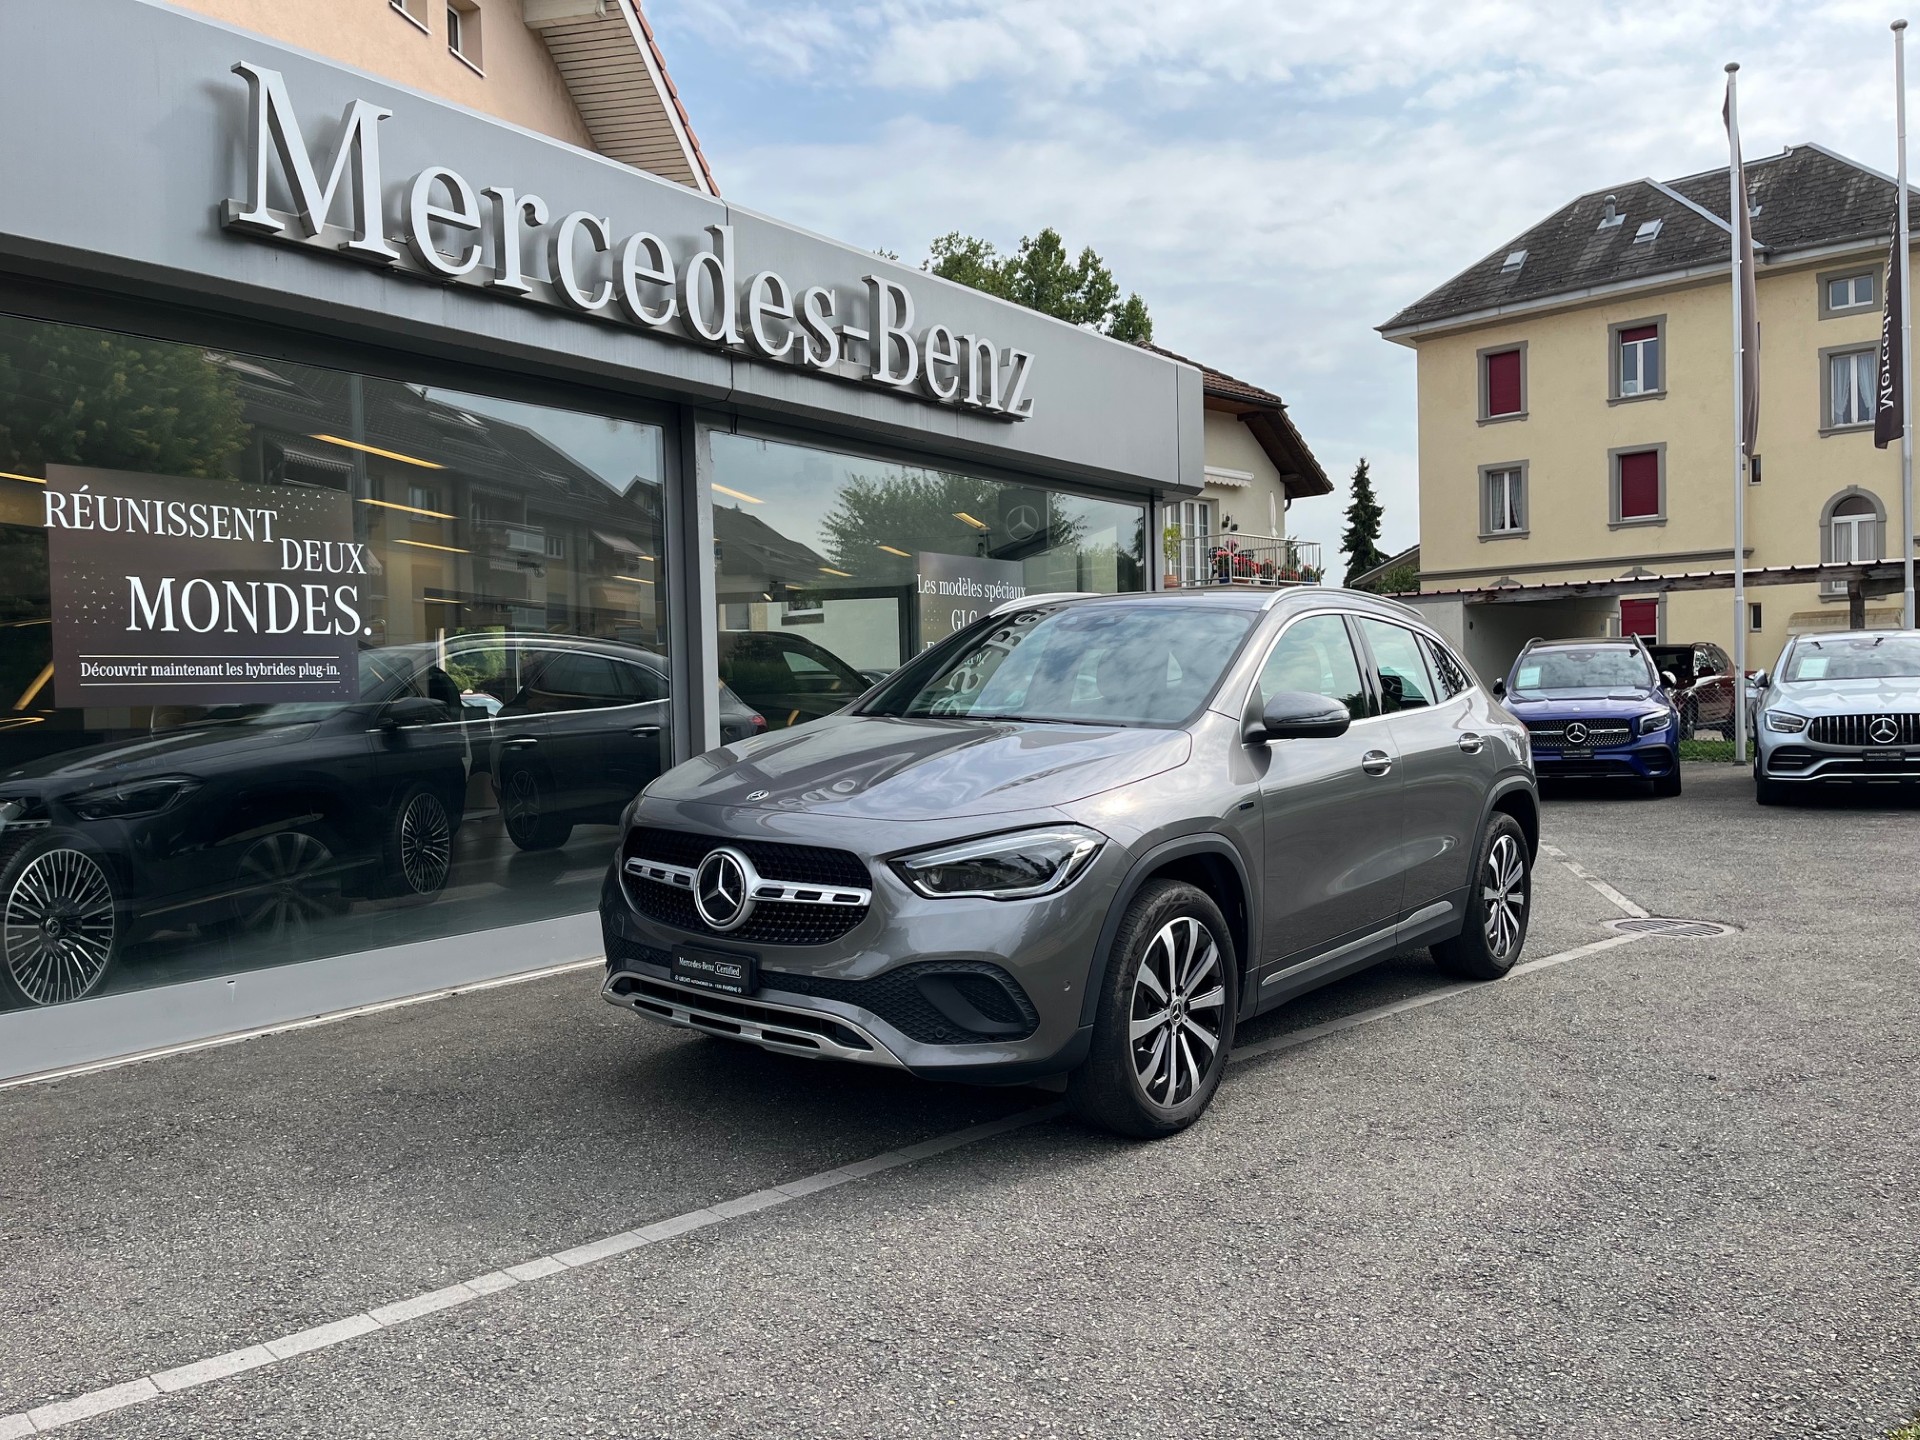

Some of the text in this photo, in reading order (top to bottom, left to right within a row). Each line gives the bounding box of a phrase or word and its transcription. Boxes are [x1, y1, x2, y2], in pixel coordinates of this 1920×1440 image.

[227, 61, 1036, 422] Mercedes-Benz
[43, 485, 278, 543] RÉUNISSENT
[281, 538, 367, 575] DEUX
[125, 576, 373, 637] MONDES.
[917, 574, 1026, 602] Les modèles spéciaux
[80, 662, 341, 679] Découvrir maintenant les hybrides plug-in.
[679, 957, 740, 976] Mercedes-Benz Certified
